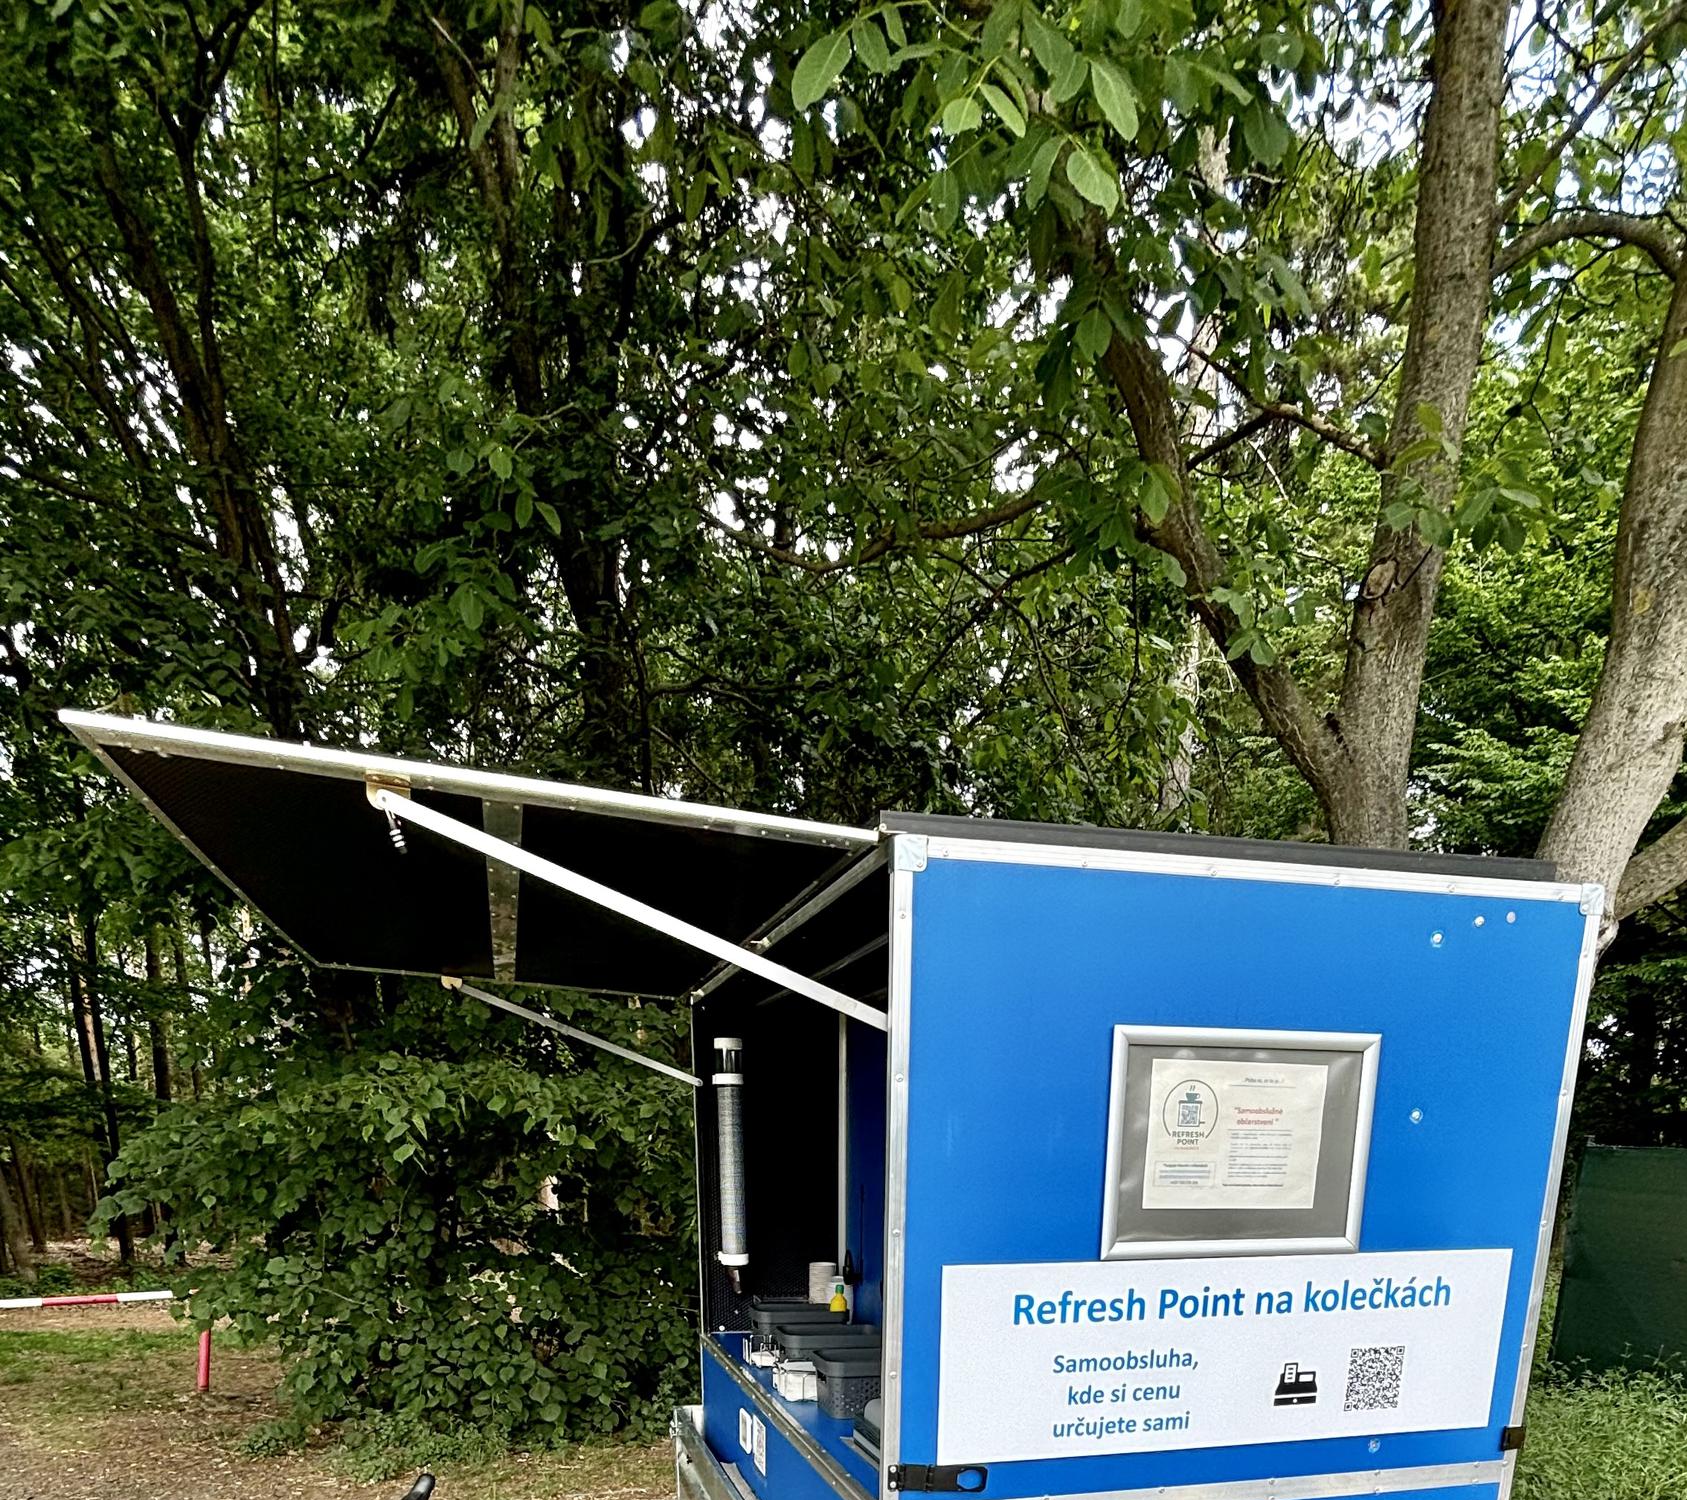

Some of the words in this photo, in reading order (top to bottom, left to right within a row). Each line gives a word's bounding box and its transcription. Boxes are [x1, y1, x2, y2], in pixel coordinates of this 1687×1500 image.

[1176, 1138, 1200, 1146] POINT
[1013, 1288, 1146, 1326] Refresh
[1158, 1286, 1246, 1320] Point
[1255, 1291, 1293, 1315] na
[1303, 1276, 1451, 1313] kolečkách
[1053, 1348, 1198, 1374] Samoobsluha,
[1068, 1384, 1105, 1405] kde
[1110, 1383, 1127, 1403] si
[1132, 1385, 1181, 1402] cenu
[1053, 1416, 1137, 1439] určujete
[1142, 1411, 1190, 1432] sami
